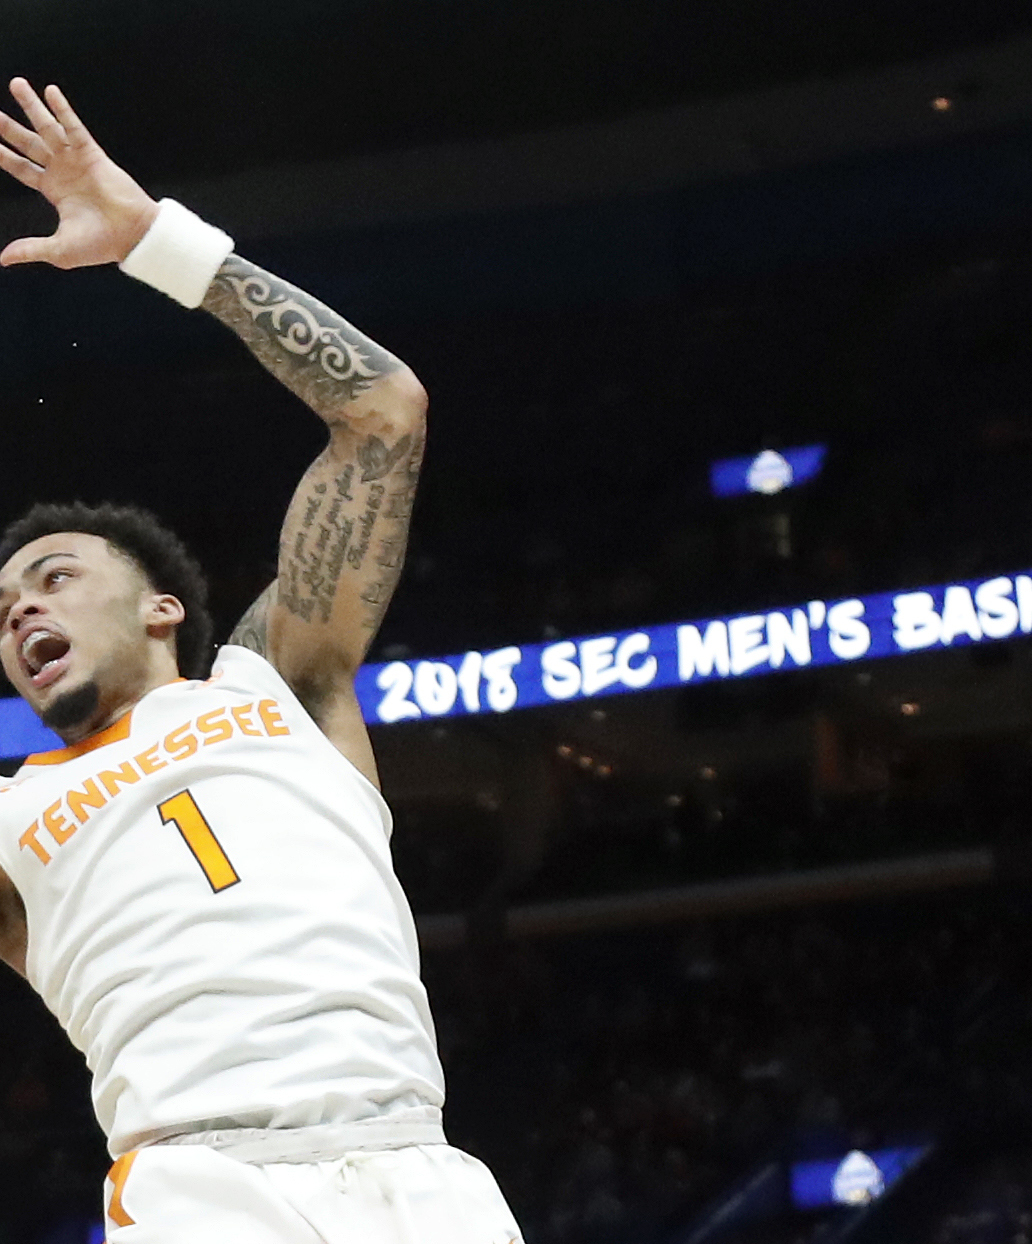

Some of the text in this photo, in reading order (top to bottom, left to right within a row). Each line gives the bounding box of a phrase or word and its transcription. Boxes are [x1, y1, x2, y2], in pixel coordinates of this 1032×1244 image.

[376, 647, 522, 722] 2018
[541, 633, 657, 699] SEC
[677, 599, 871, 681] MEN'S
[19, 699, 290, 866] TENNESSEE
[156, 788, 241, 894] 1
